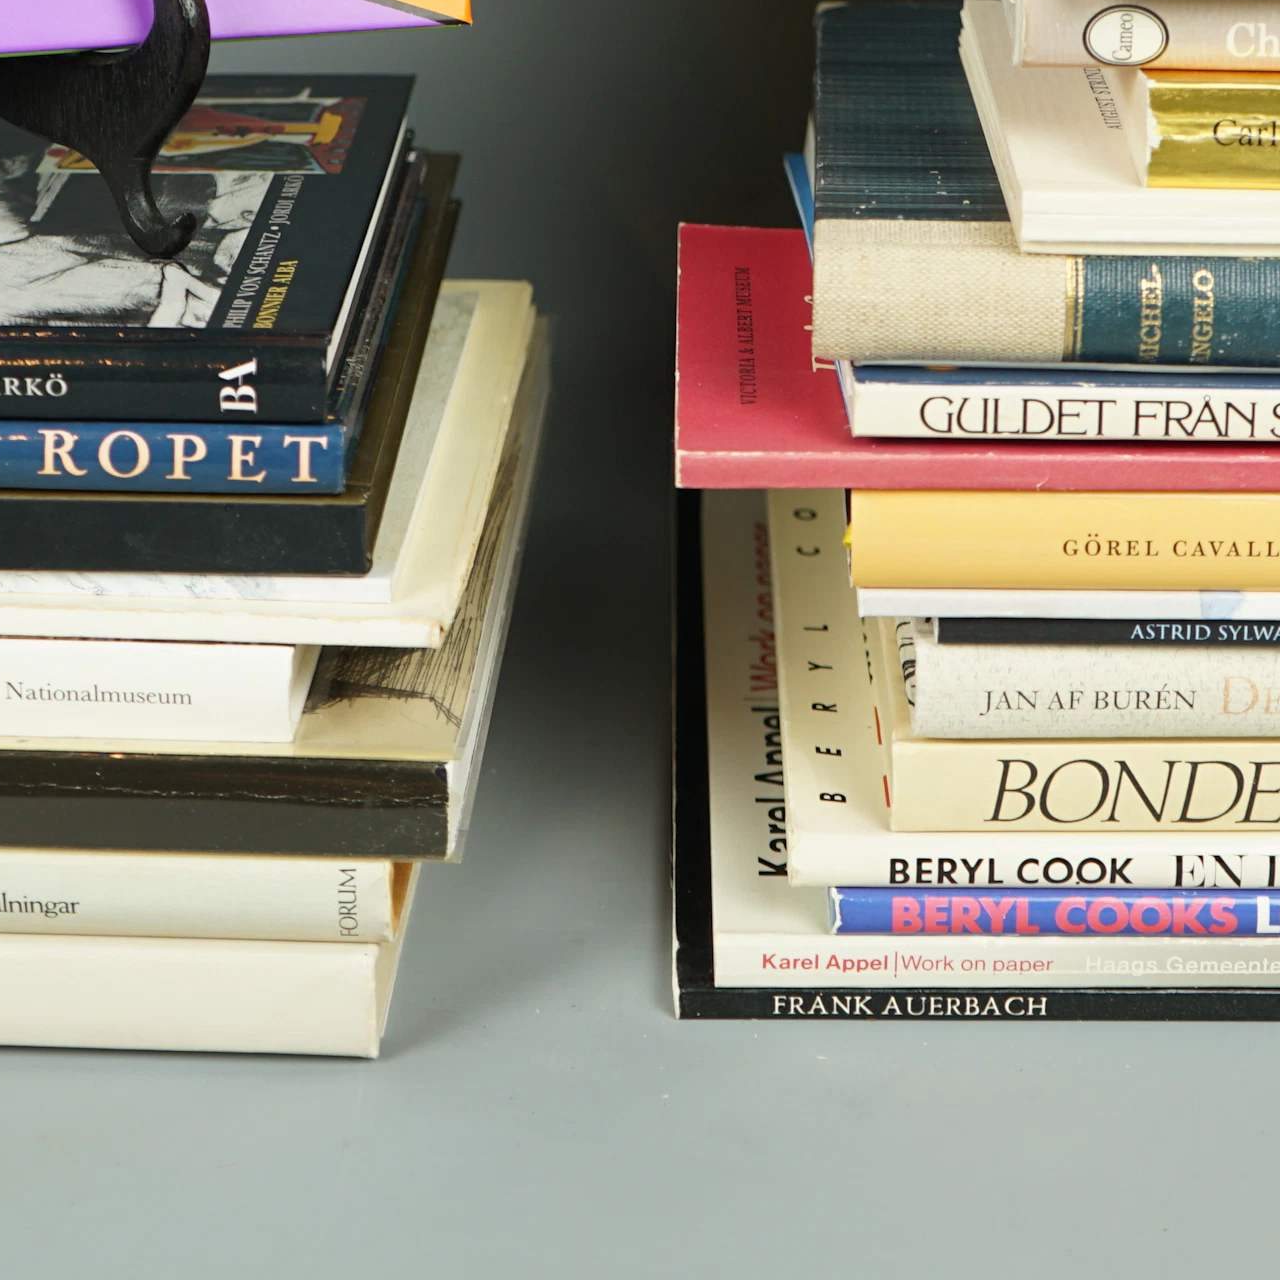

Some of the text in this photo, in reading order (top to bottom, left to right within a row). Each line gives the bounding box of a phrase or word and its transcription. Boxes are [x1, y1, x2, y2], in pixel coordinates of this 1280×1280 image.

[1111, 13, 1134, 62] Cameo
[1094, 97, 1123, 130] AUGUST
[1213, 119, 1277, 148] Carl
[269, 199, 295, 225] JORDI
[247, 232, 282, 275] SCHANTZ
[237, 276, 262, 297] VON
[252, 259, 299, 329] BONNIER ALBA
[222, 298, 253, 329] PHILIP
[734, 266, 757, 405] VICTORIA ALBERT MUSEUM
[920, 396, 1116, 438] GULDET
[1132, 395, 1257, 439] FRÅN
[38, 428, 329, 483] ROPET
[1063, 534, 1160, 559] GÖREL
[1131, 623, 1211, 642] ASTRID
[4, 681, 193, 706] Nationalmuseum
[980, 683, 1197, 716] JAN AF BURÉN
[803, 624, 847, 803] BERYL
[889, 858, 1003, 885] BERYL
[1016, 857, 1134, 886] COOK
[1168, 855, 1250, 888] EN
[339, 867, 357, 937] FORUM
[891, 897, 1041, 934] BERYL
[1055, 897, 1238, 935] COOKS
[762, 953, 819, 971] Karel
[825, 953, 889, 975] Appel
[902, 954, 954, 973] Work
[961, 960, 986, 973] on
[993, 960, 1054, 976] paper
[1086, 956, 1158, 976] Haags
[773, 994, 1048, 1017] FRANK AUERBACH
